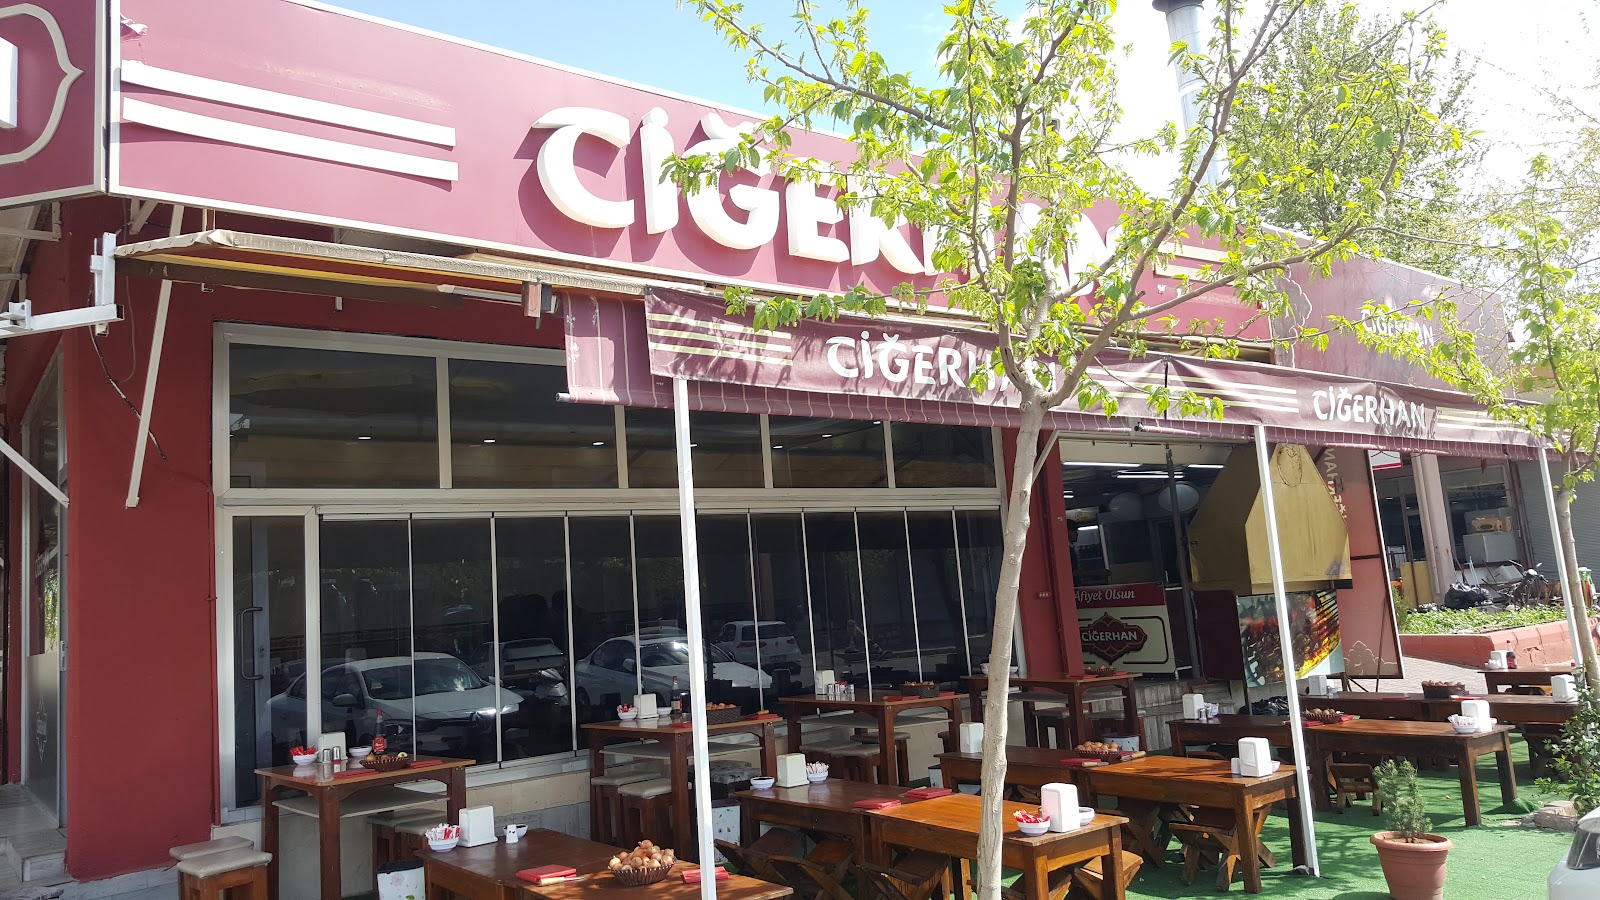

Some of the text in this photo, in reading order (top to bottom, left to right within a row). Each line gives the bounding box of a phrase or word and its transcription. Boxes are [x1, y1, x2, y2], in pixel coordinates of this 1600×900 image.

[826, 330, 1056, 392] CİĞERH
[1312, 385, 1426, 429] CİĞERHAN
[1075, 589, 1135, 603] Afiyet Olsun
[1081, 630, 1138, 641] CİĞERHAN
